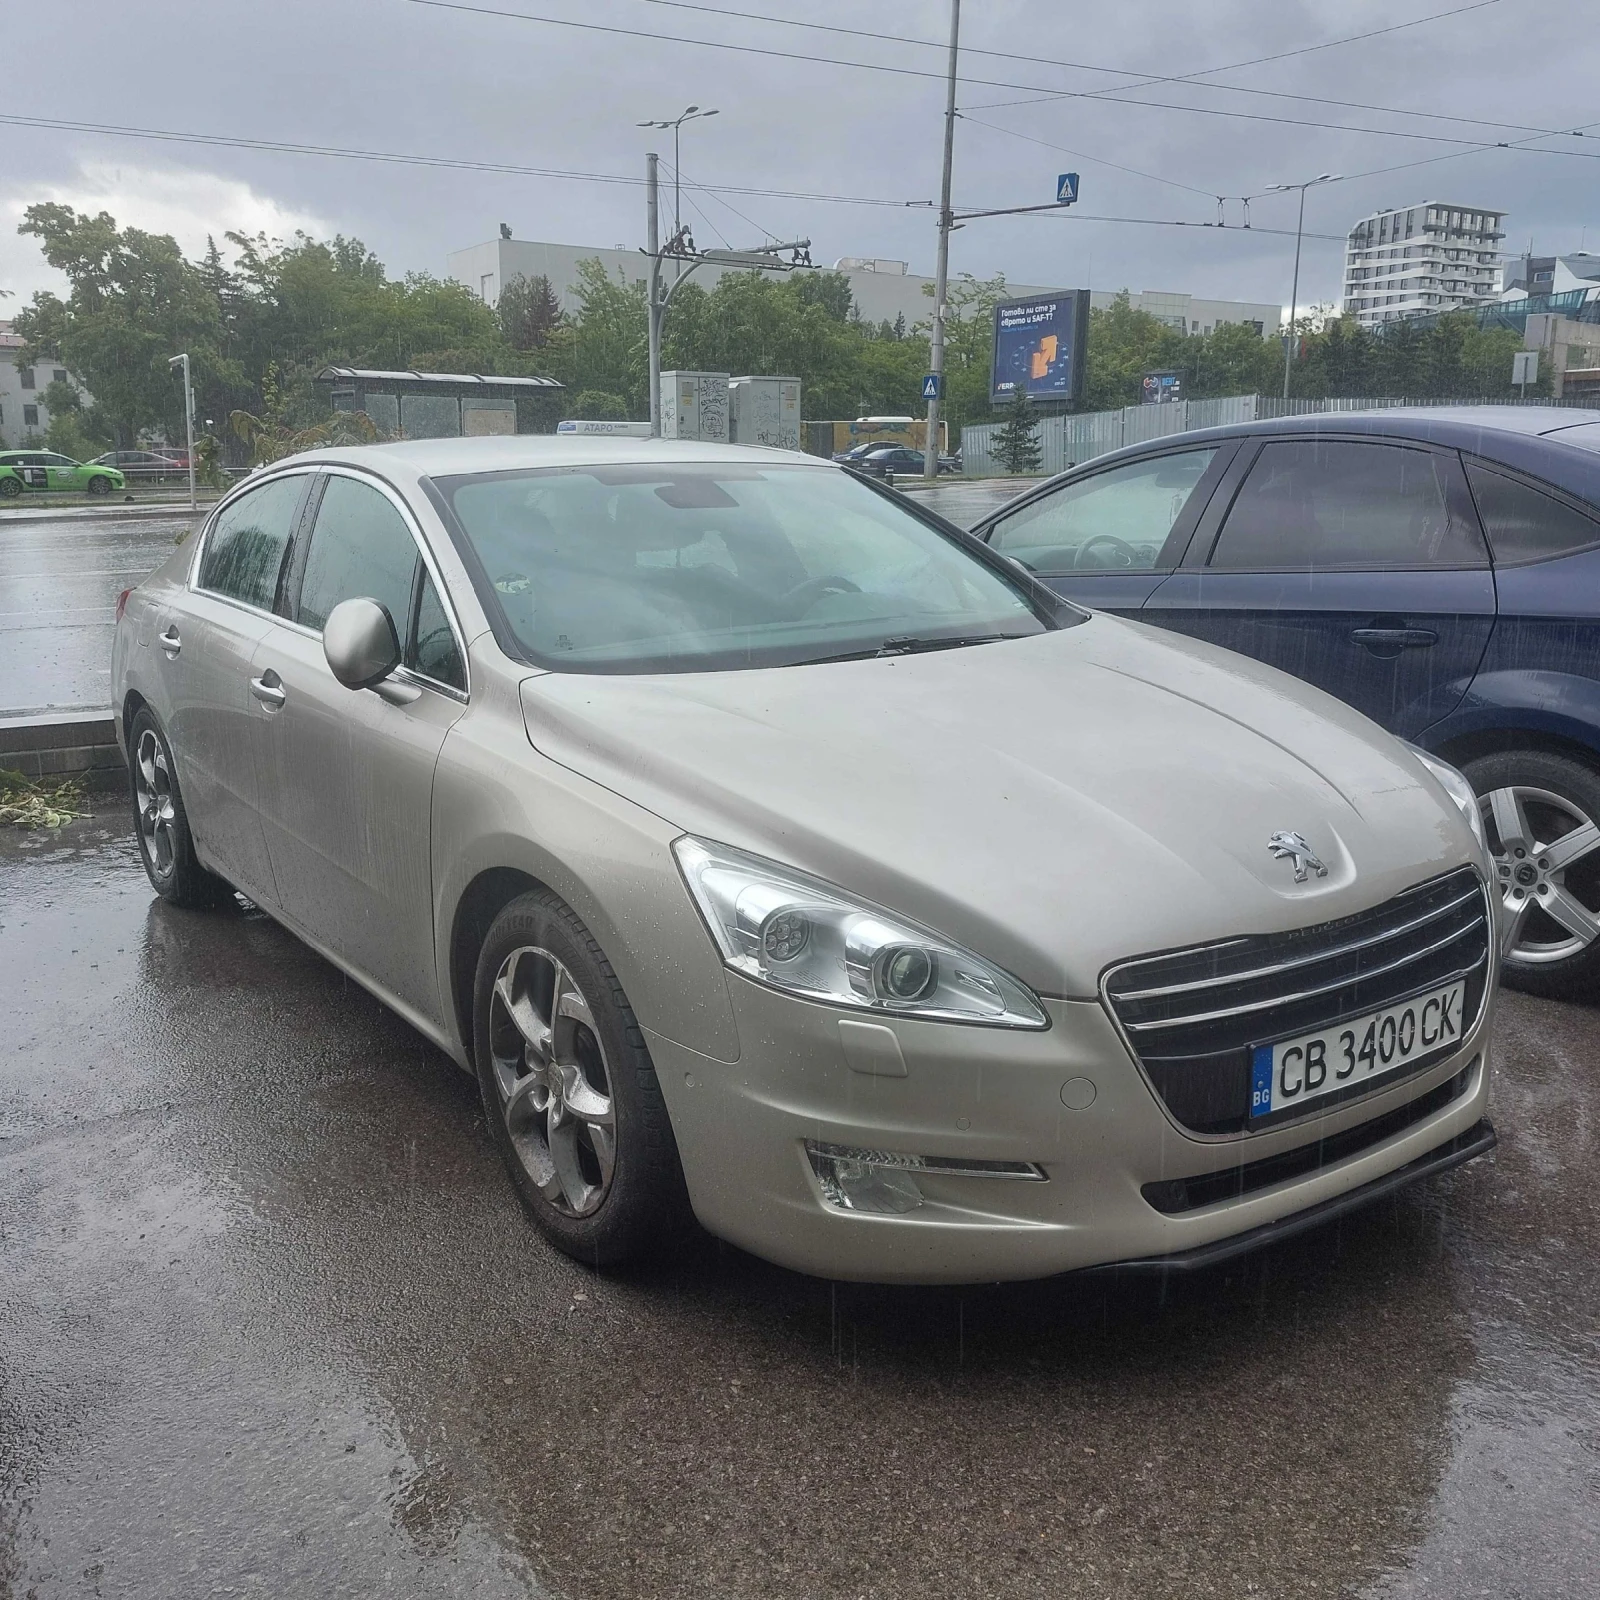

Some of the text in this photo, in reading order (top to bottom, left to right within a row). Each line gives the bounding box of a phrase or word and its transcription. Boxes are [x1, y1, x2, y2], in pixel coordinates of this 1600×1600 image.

[1001, 304, 1057, 317] Готови ли сте за
[1001, 318, 1026, 327] еврото
[1032, 313, 1053, 323] SAF-T?
[1288, 914, 1363, 940] PEUGEOT
[1279, 988, 1458, 1098] CB 3400 CK
[1253, 1090, 1270, 1107] BG
